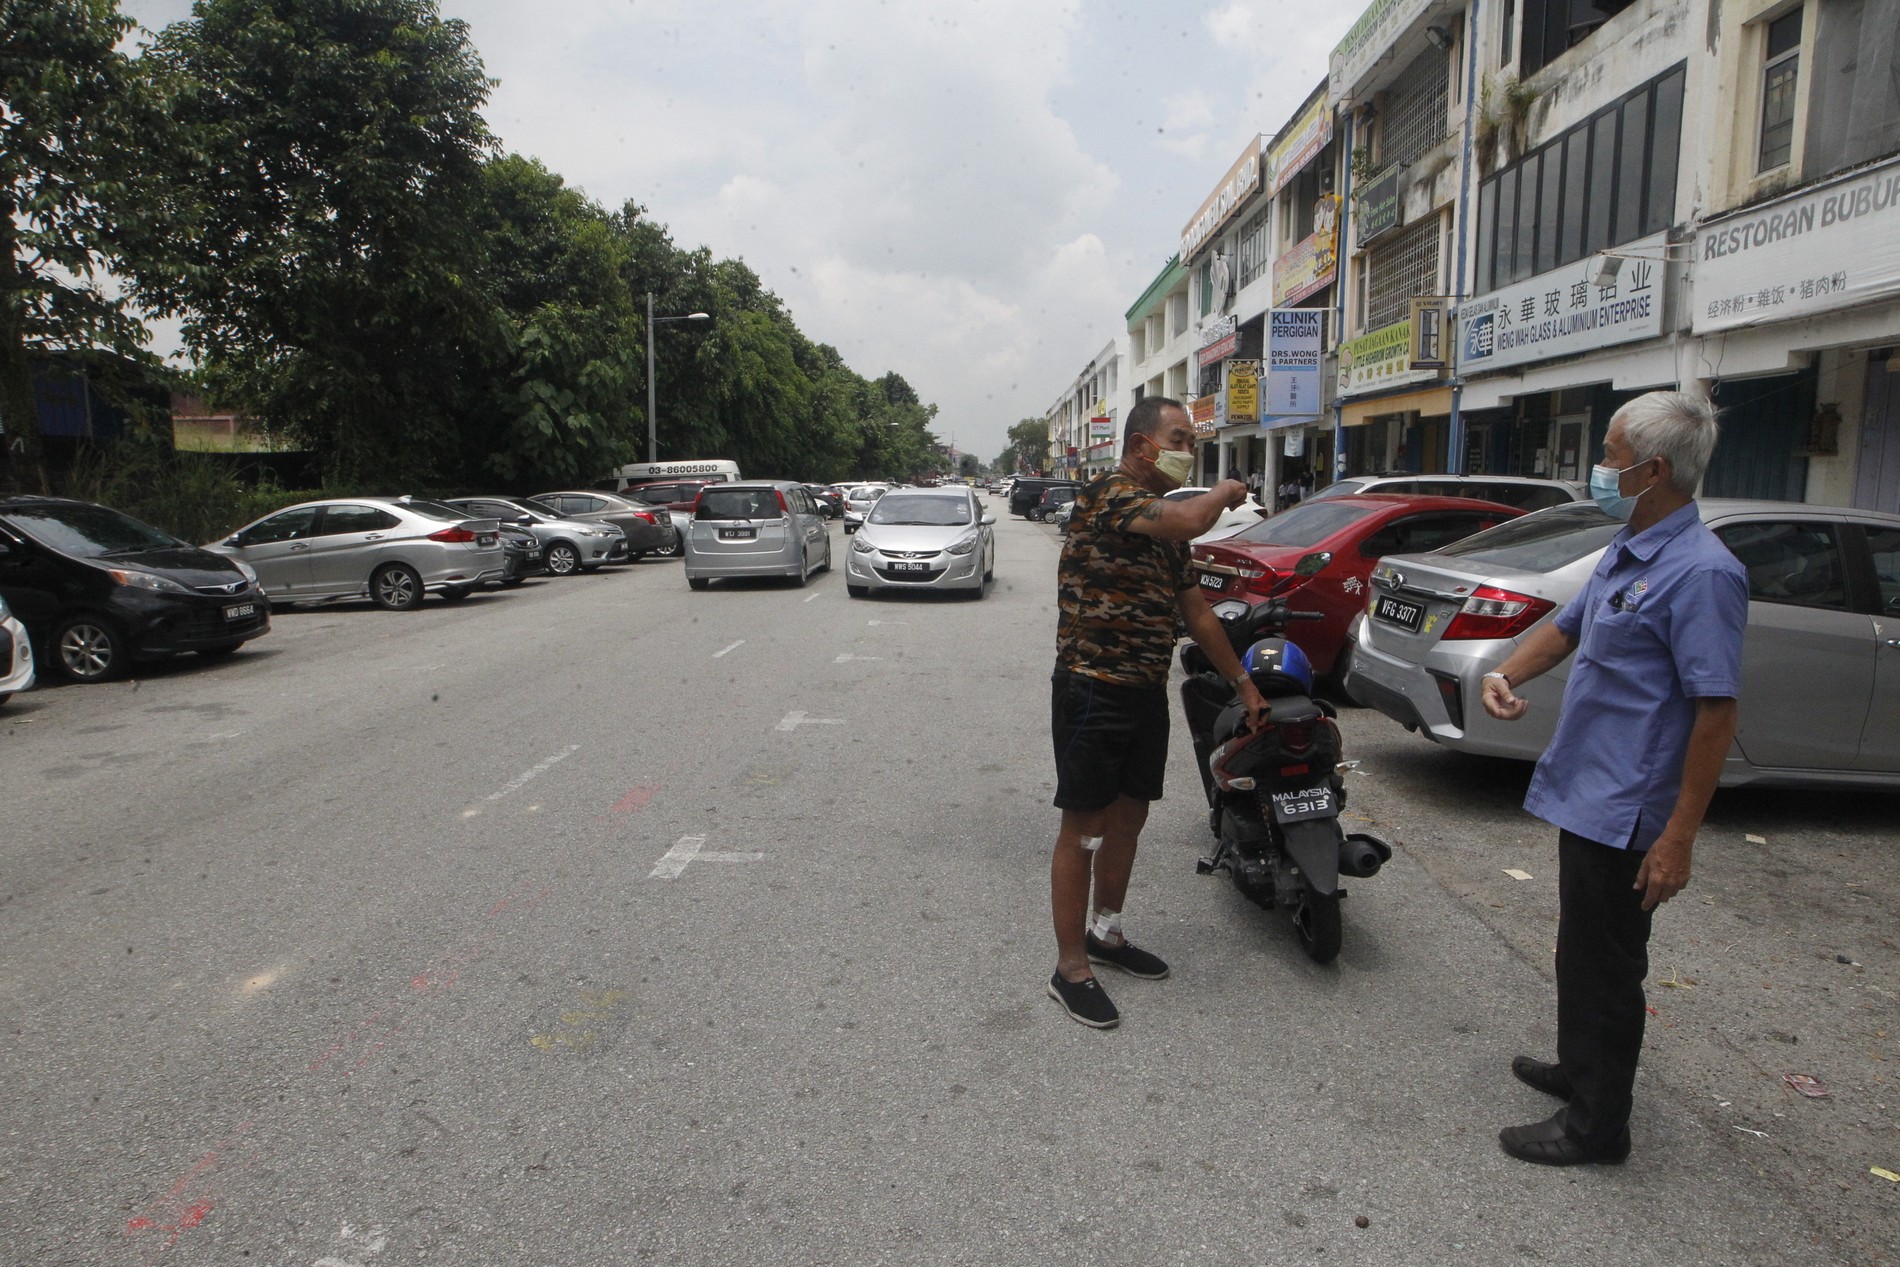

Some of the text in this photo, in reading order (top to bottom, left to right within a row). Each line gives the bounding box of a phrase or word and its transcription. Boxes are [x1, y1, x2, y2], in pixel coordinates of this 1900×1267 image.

[1704, 203, 1815, 261] RESTORAN
[1272, 312, 1318, 324] KLINIK
[1515, 327, 1529, 347] WAH
[1530, 321, 1551, 343] GLASS
[1552, 320, 1558, 338] &
[1558, 310, 1598, 336] ALUMINIUM
[1600, 295, 1651, 327] ENTERPRISE
[1272, 325, 1318, 338] PERGIGIAN
[1470, 321, 1493, 356] 永華
[648, 464, 718, 475] 03-86005800
[908, 563, 923, 571] 5044
[1209, 575, 1223, 589] 5723
[1382, 599, 1417, 624] VFG 3377
[1272, 787, 1331, 802] MALAYSIA
[1283, 800, 1328, 815] 6313
